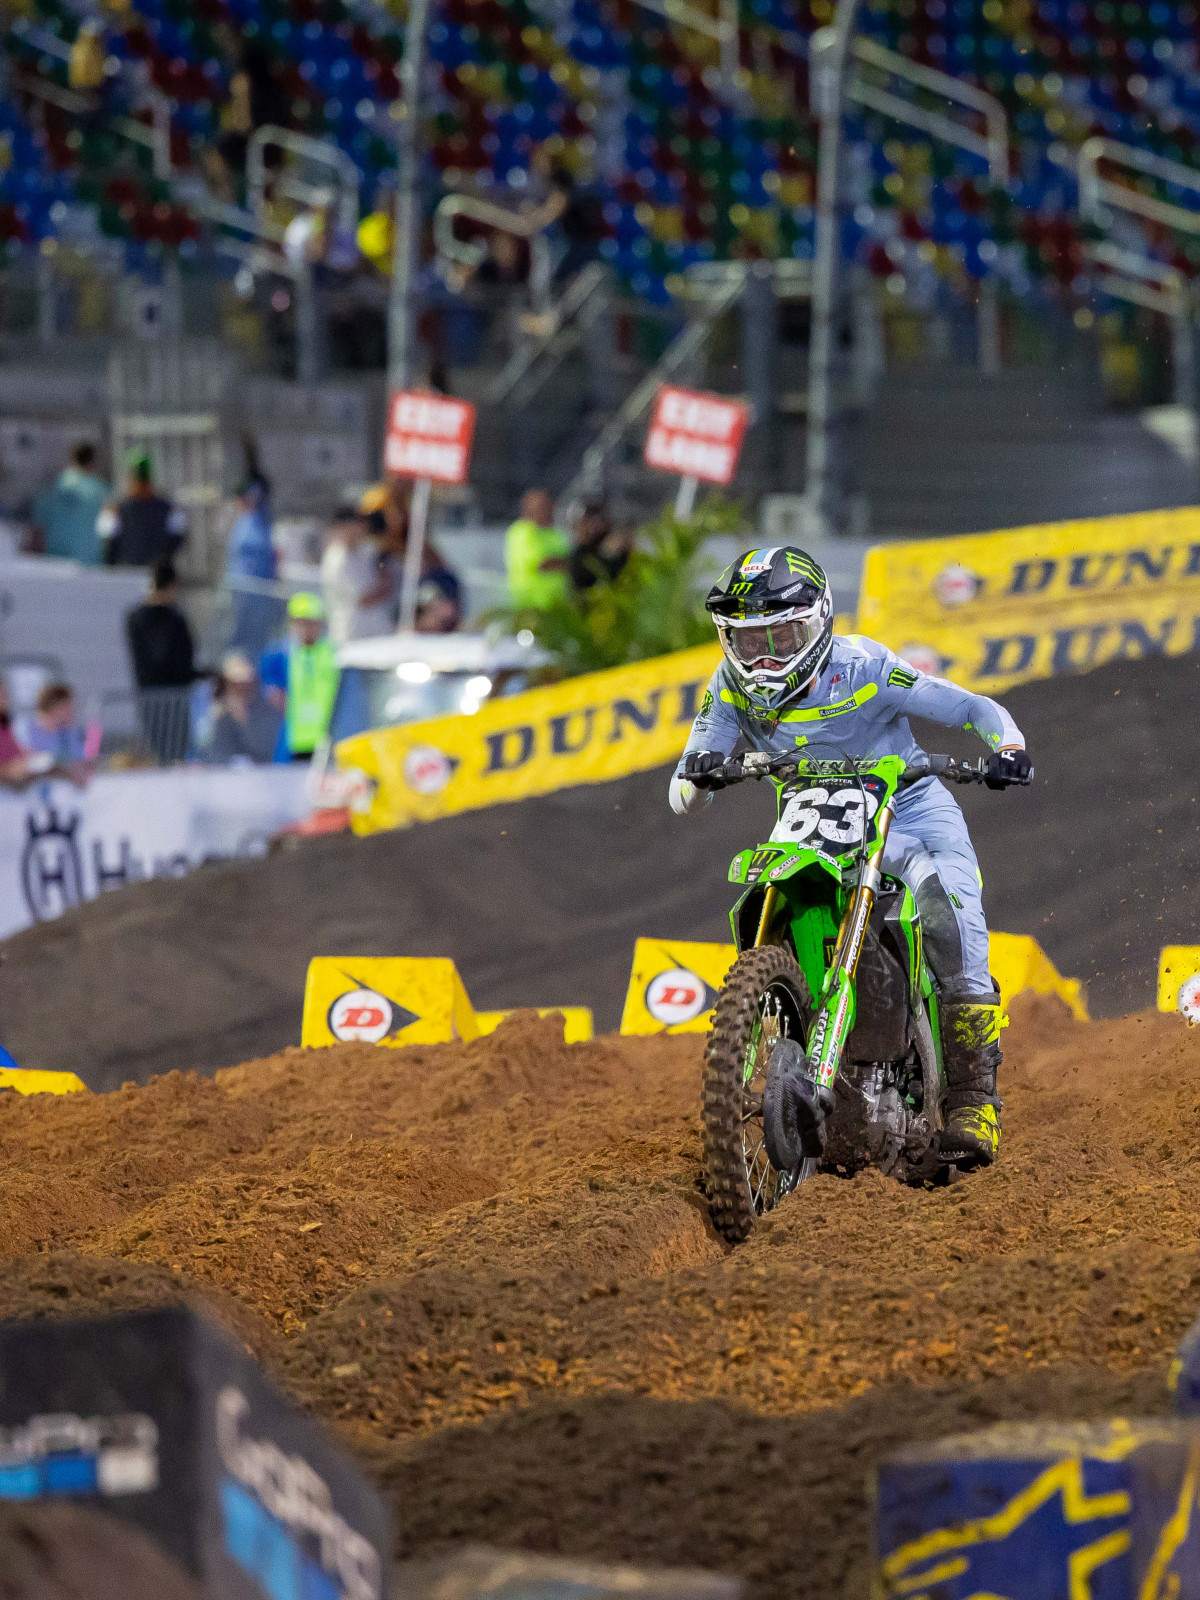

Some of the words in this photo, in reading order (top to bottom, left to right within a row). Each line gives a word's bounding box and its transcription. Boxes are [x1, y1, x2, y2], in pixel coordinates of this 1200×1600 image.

[743, 565, 767, 573] BELL
[799, 632, 830, 673] MONSTER
[819, 699, 857, 717] Kawasaki
[482, 683, 700, 775] DUNL
[777, 787, 879, 844] 63
